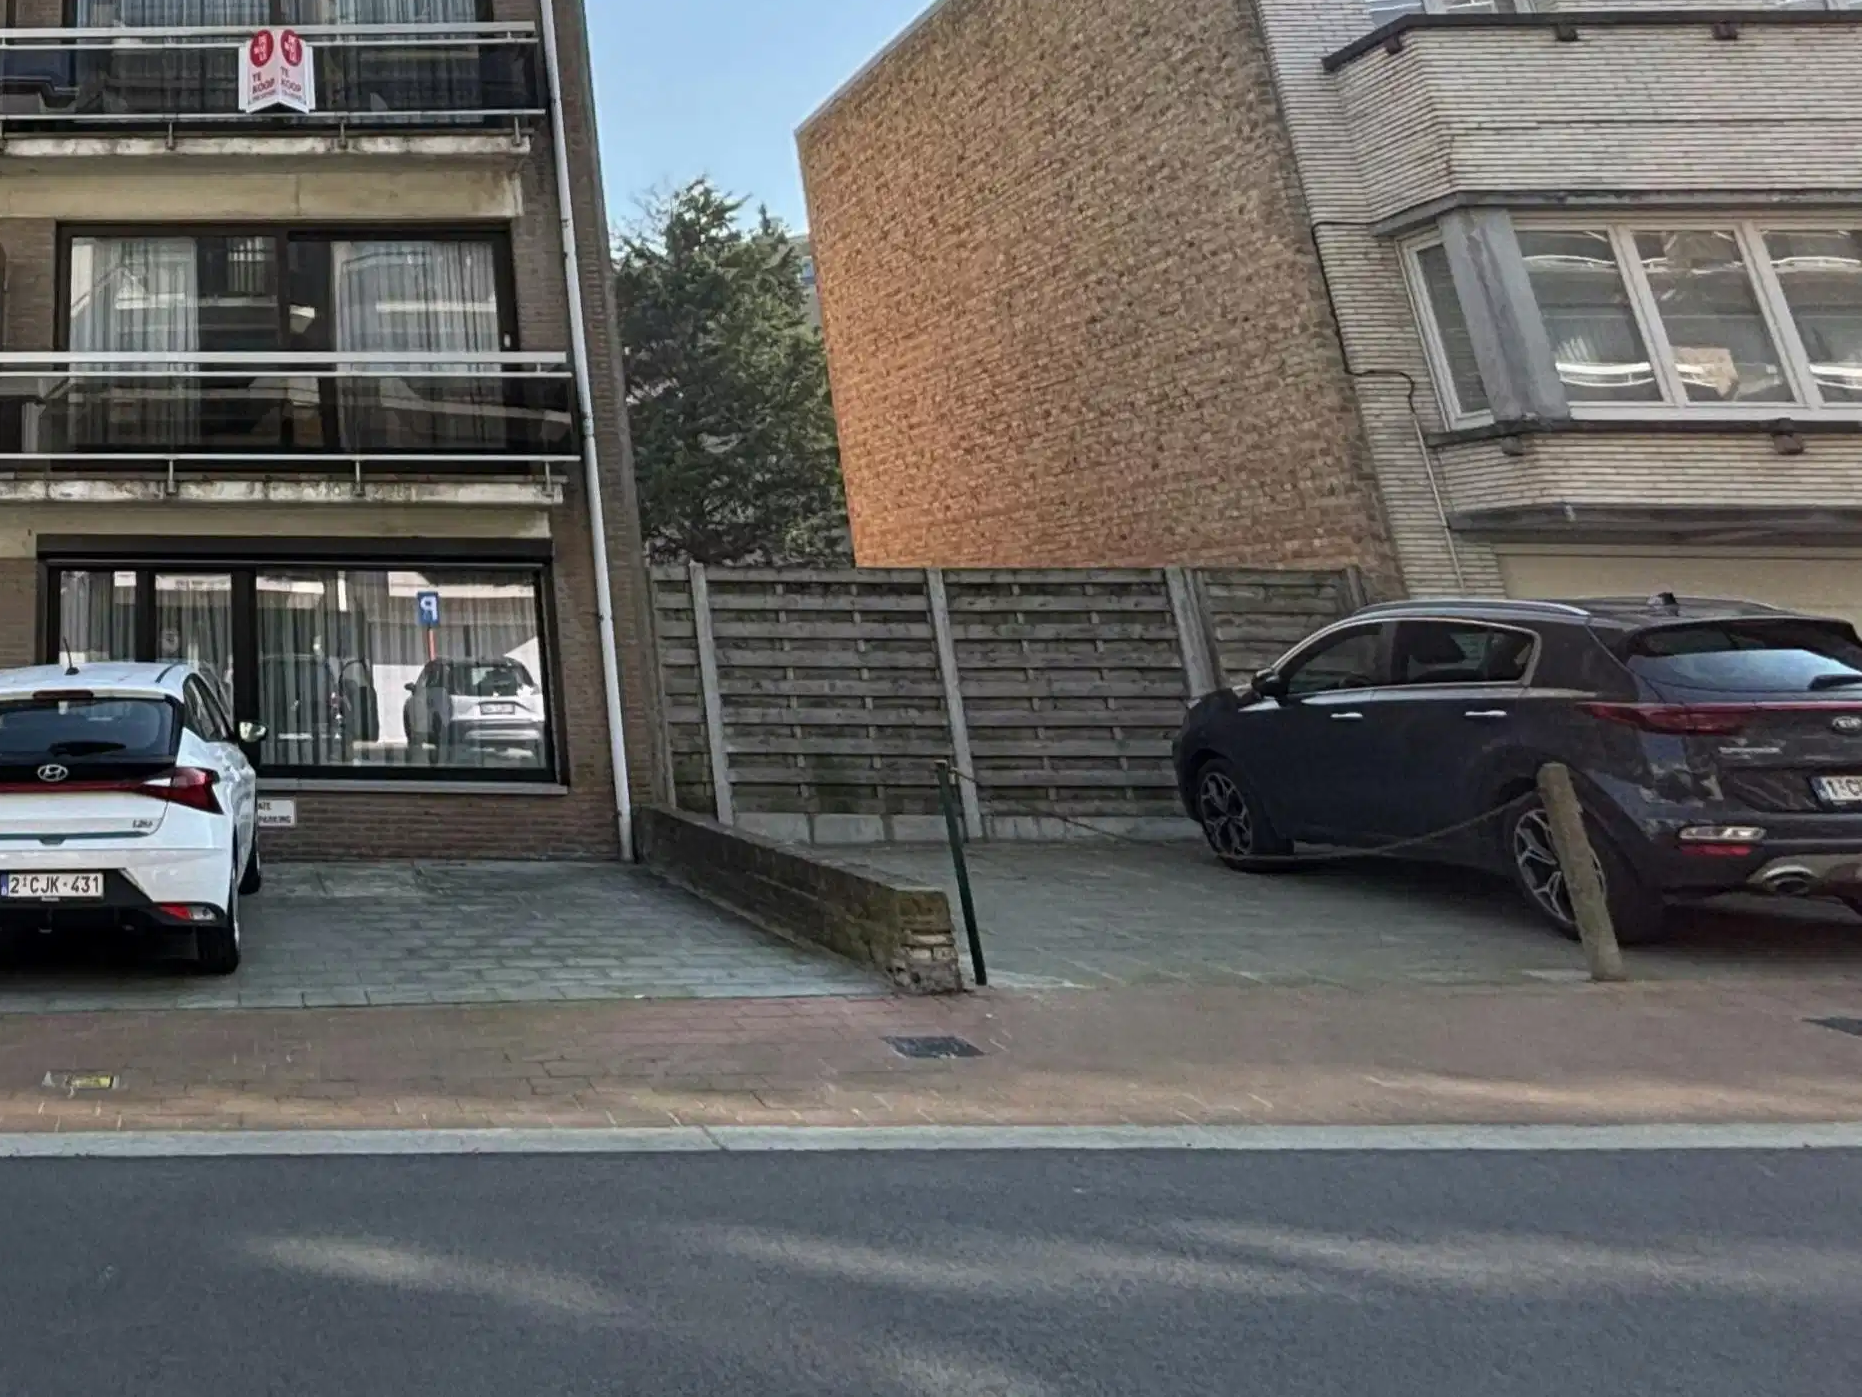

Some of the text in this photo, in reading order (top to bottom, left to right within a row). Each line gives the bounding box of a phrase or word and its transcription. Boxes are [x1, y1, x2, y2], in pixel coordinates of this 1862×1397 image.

[252, 72, 262, 83] TE
[252, 78, 275, 94] KOOP
[281, 78, 302, 92] KOOP
